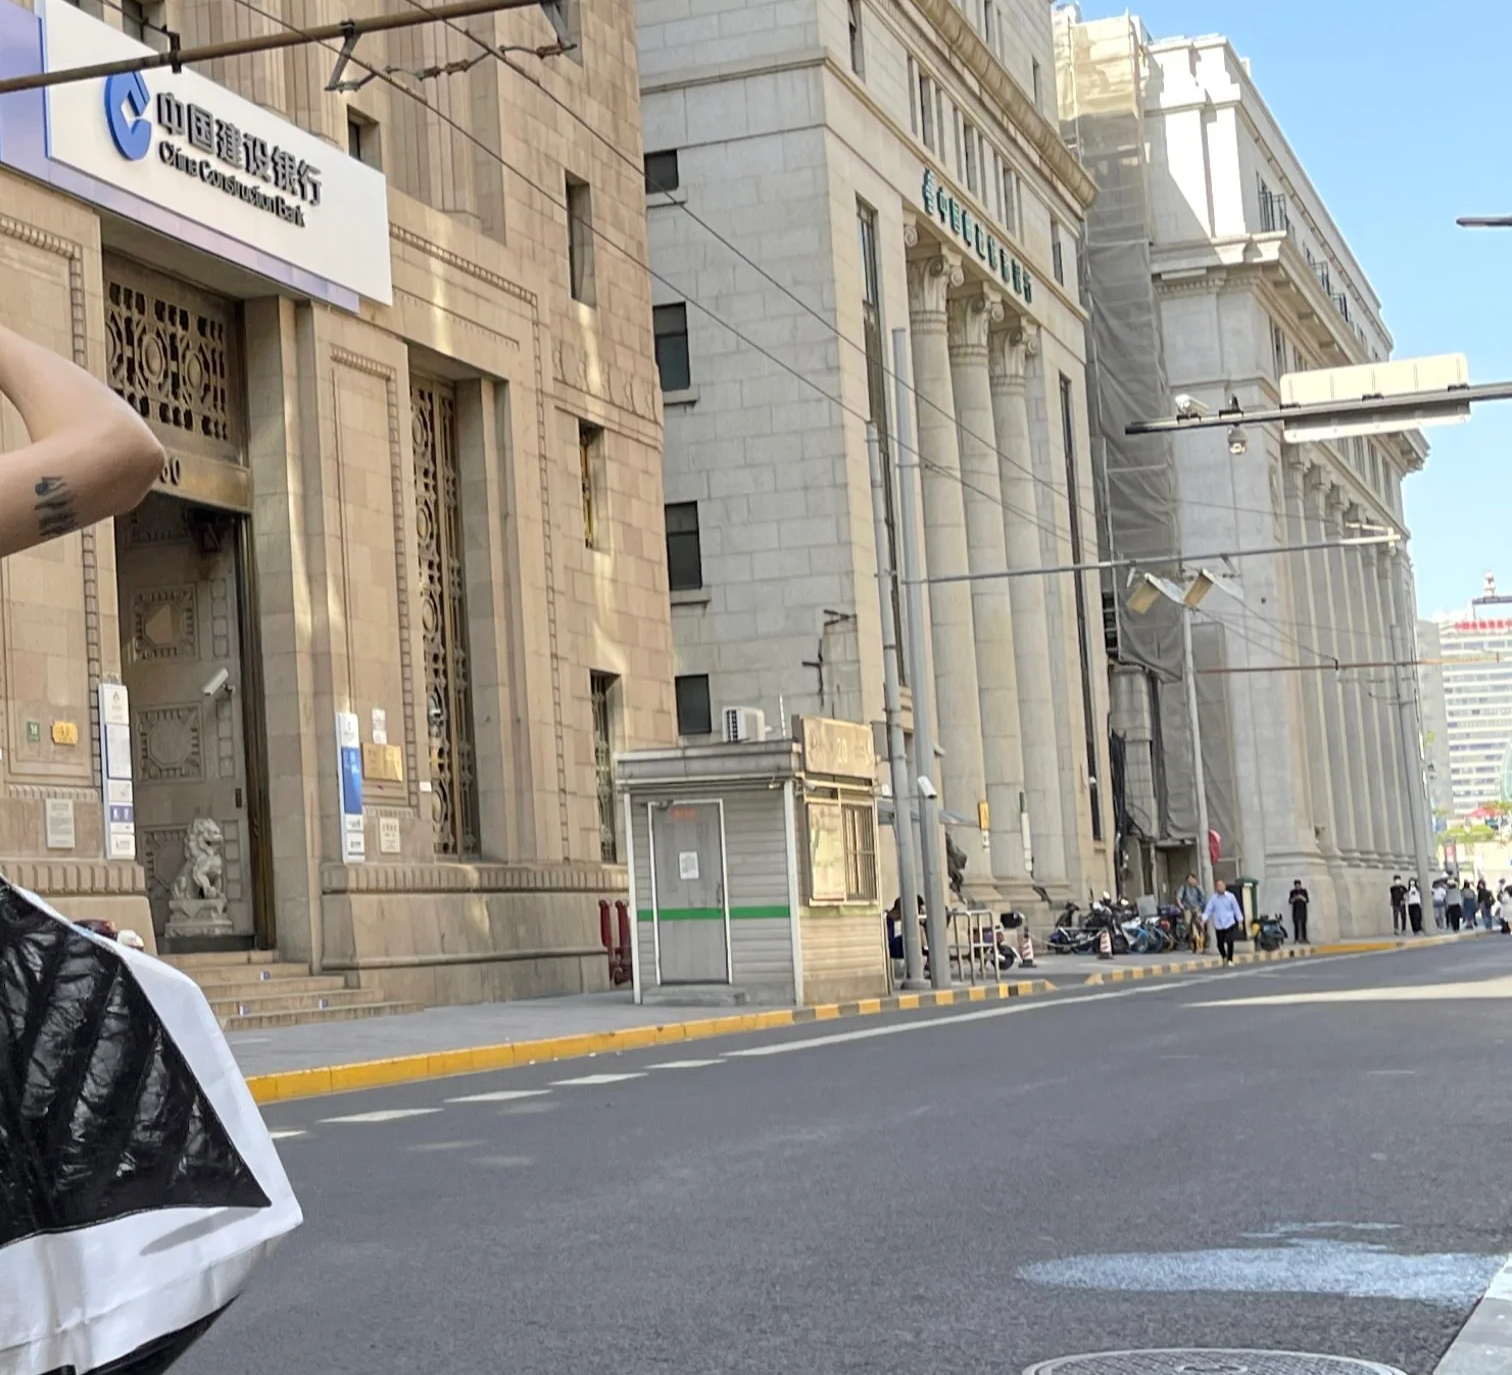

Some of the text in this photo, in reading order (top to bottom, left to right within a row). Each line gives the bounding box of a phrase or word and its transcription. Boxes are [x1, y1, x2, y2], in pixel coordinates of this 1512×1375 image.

[156, 90, 323, 206] 中国建设银行
[158, 140, 198, 177] China
[274, 195, 306, 228] Bank
